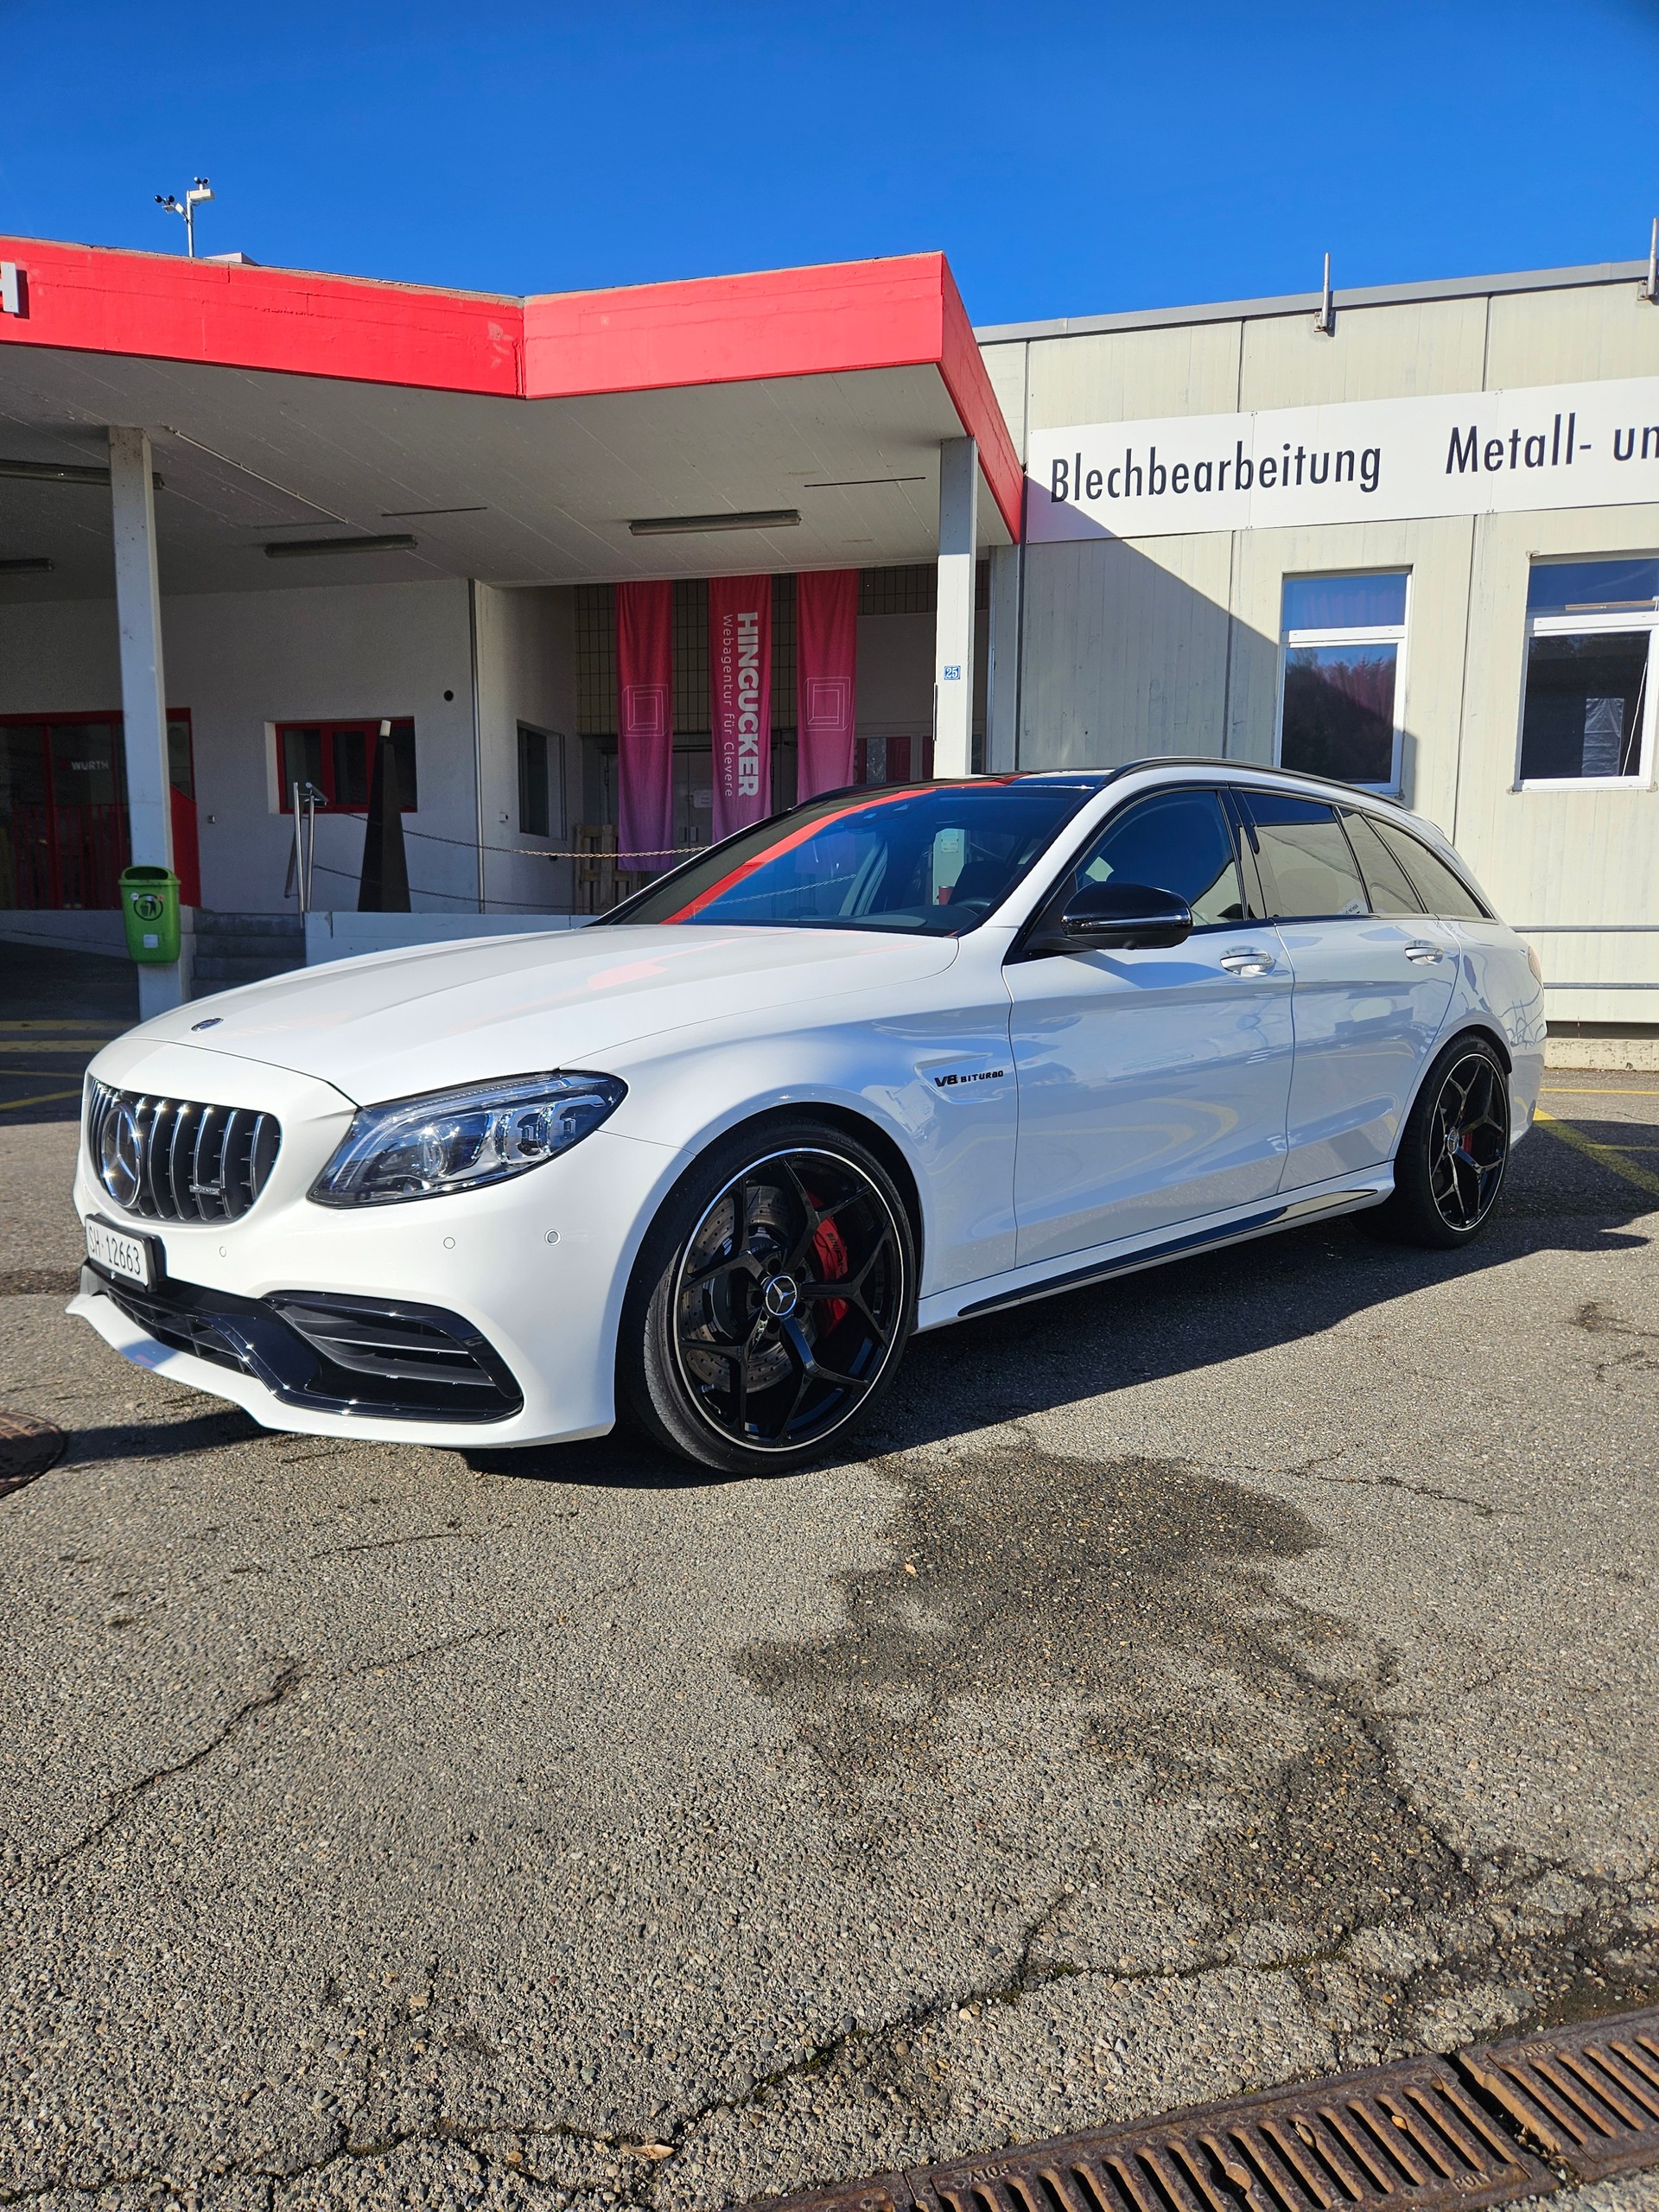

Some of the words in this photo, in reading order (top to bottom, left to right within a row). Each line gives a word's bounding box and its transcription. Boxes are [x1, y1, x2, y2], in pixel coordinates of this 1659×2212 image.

[1445, 411, 1592, 474] Metall-
[1051, 440, 1382, 504] Blechbearbeitung
[721, 613, 734, 707] Webagentur
[946, 667, 958, 678] 25
[723, 713, 735, 735] für
[737, 611, 760, 798] HINGUCKER
[723, 741, 735, 798] Clevere
[934, 1074, 958, 1087] V8
[960, 1070, 1004, 1083] BITURBO
[105, 1234, 141, 1275] 12663
